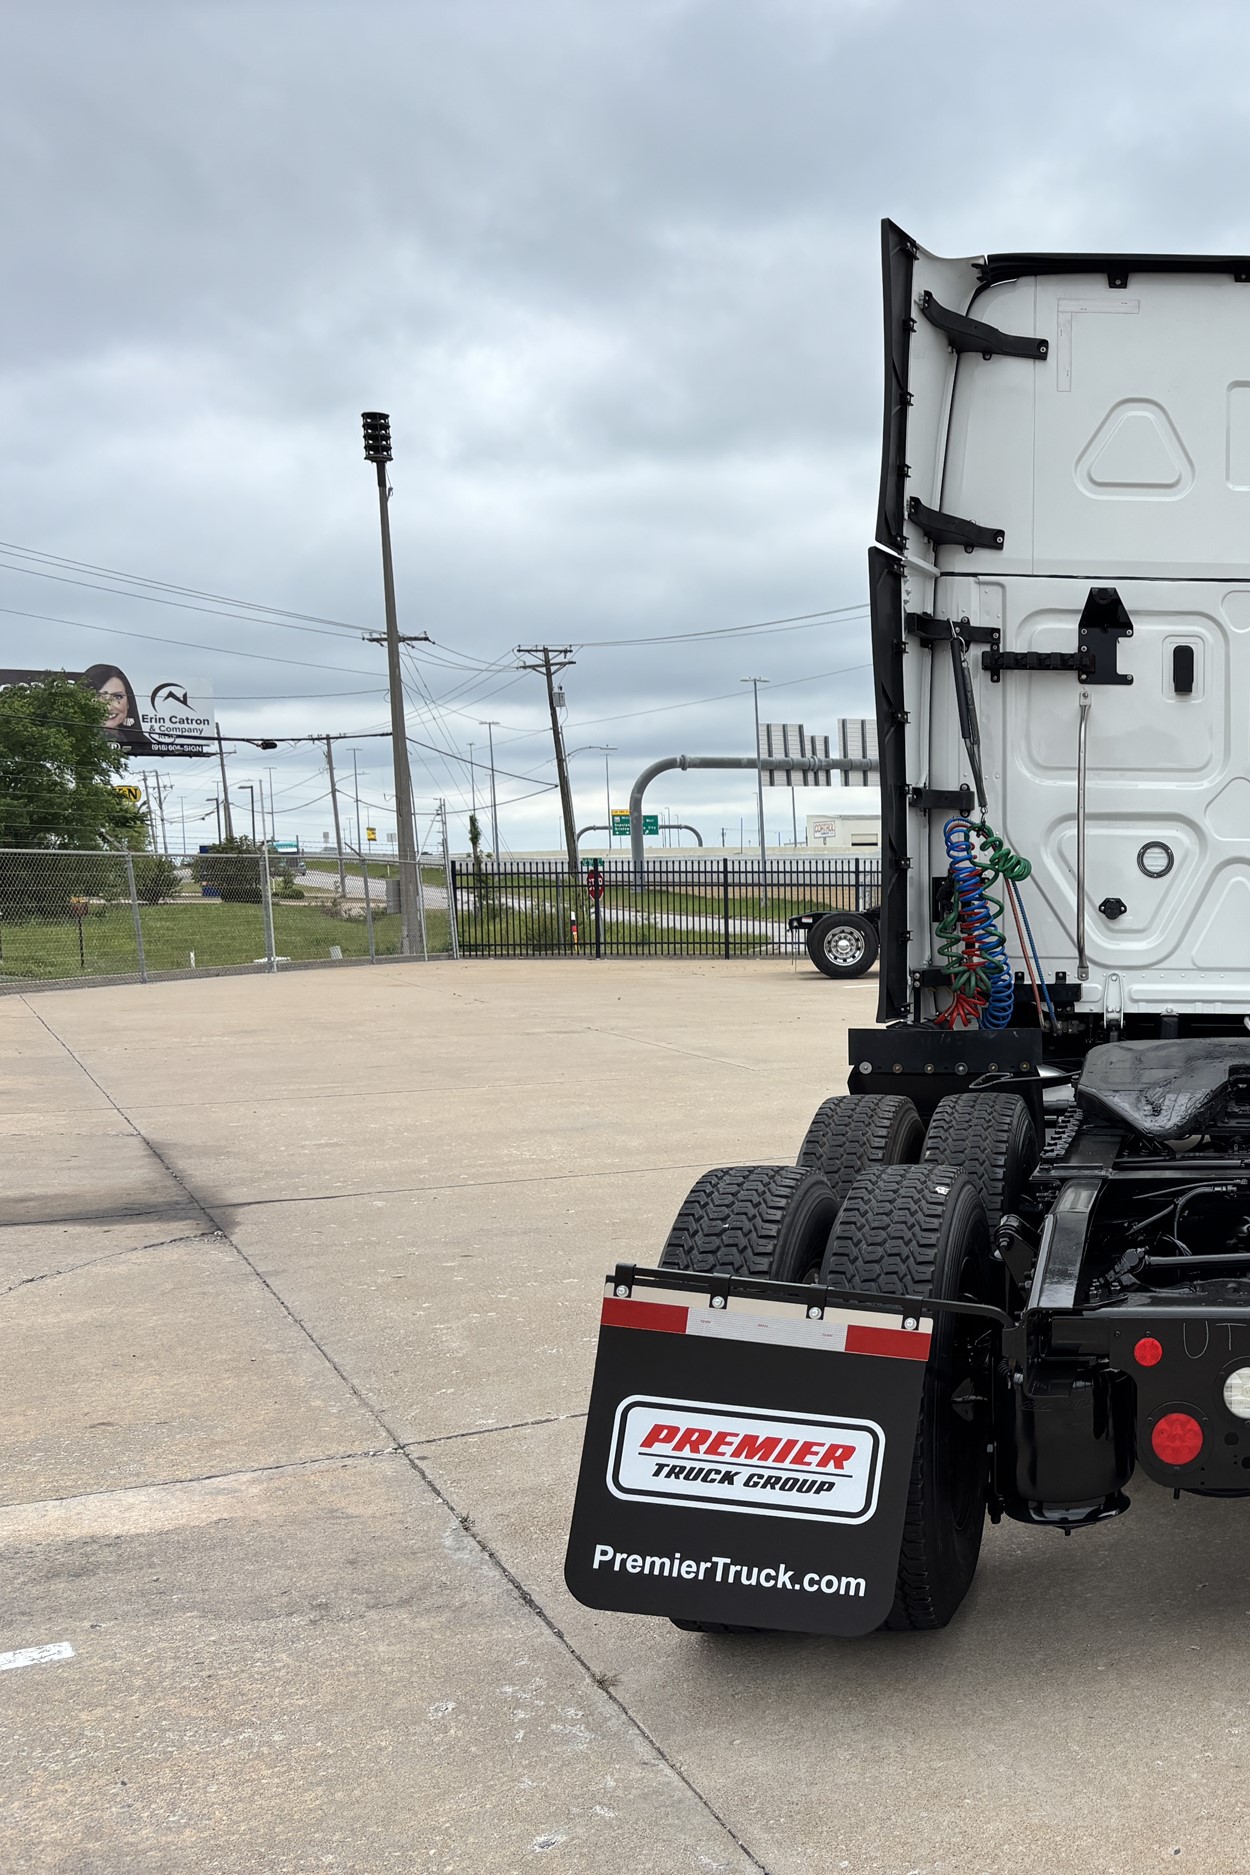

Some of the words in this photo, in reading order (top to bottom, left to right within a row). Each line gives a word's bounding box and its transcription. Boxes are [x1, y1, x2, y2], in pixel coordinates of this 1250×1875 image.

[141, 714, 166, 724] Erin
[169, 715, 210, 726] Catron
[158, 725, 204, 735] Company
[589, 878, 603, 891] STP
[640, 1423, 857, 1470] PREMIER
[652, 1463, 742, 1486] TRUCK
[743, 1473, 835, 1495] GROUP
[592, 1543, 866, 1597] PremierTruck.com
